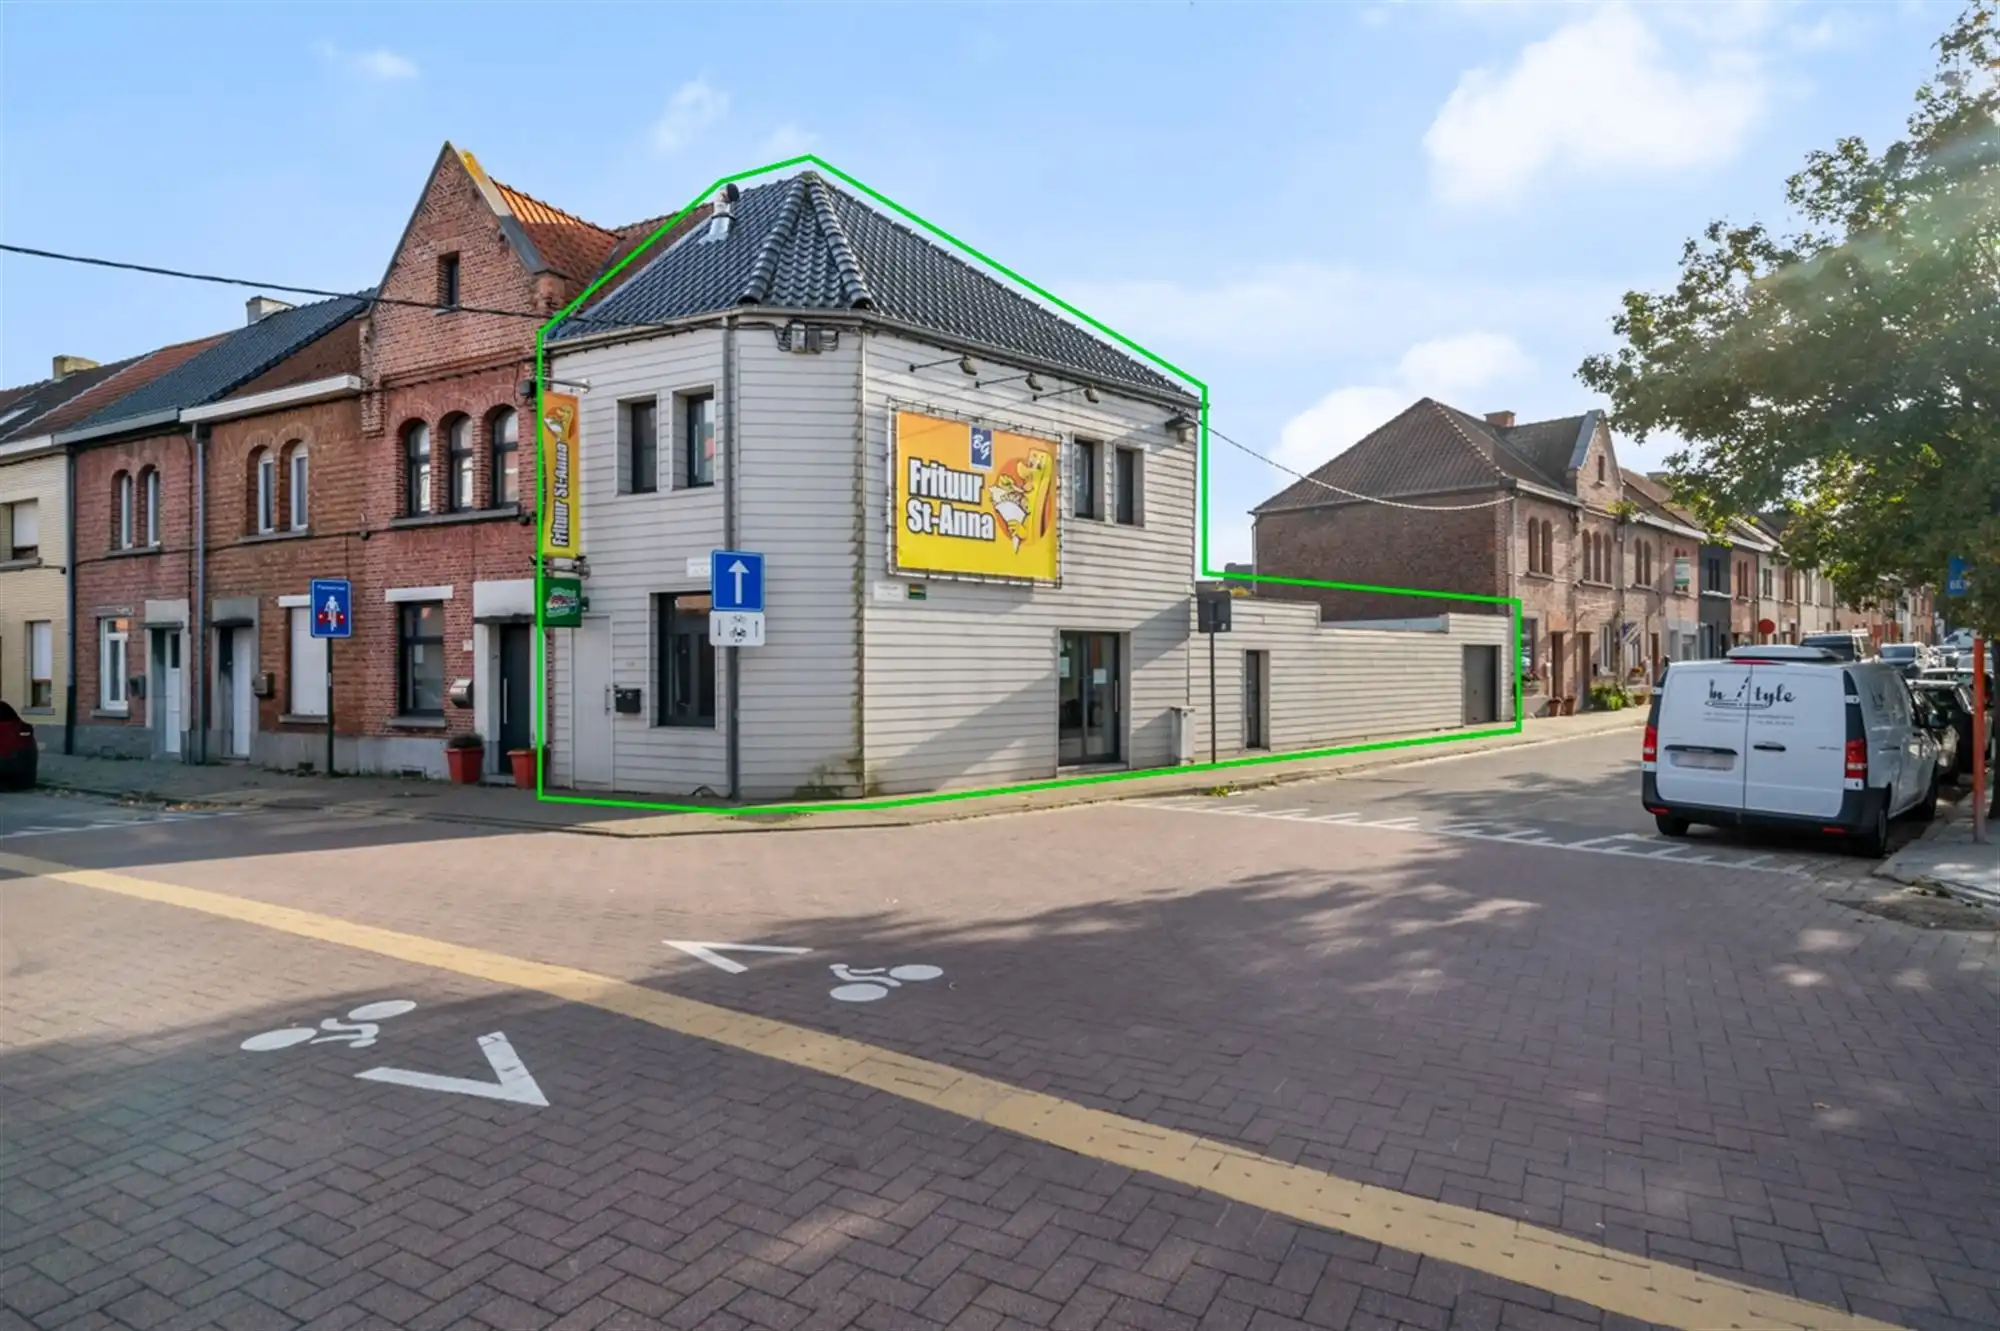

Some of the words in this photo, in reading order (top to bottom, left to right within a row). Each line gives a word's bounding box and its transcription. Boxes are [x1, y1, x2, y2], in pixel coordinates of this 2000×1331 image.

[553, 441, 570, 499] St-Anna
[908, 457, 984, 505] Frituur
[551, 499, 570, 547] Frituur
[906, 499, 996, 541] St-Anna
